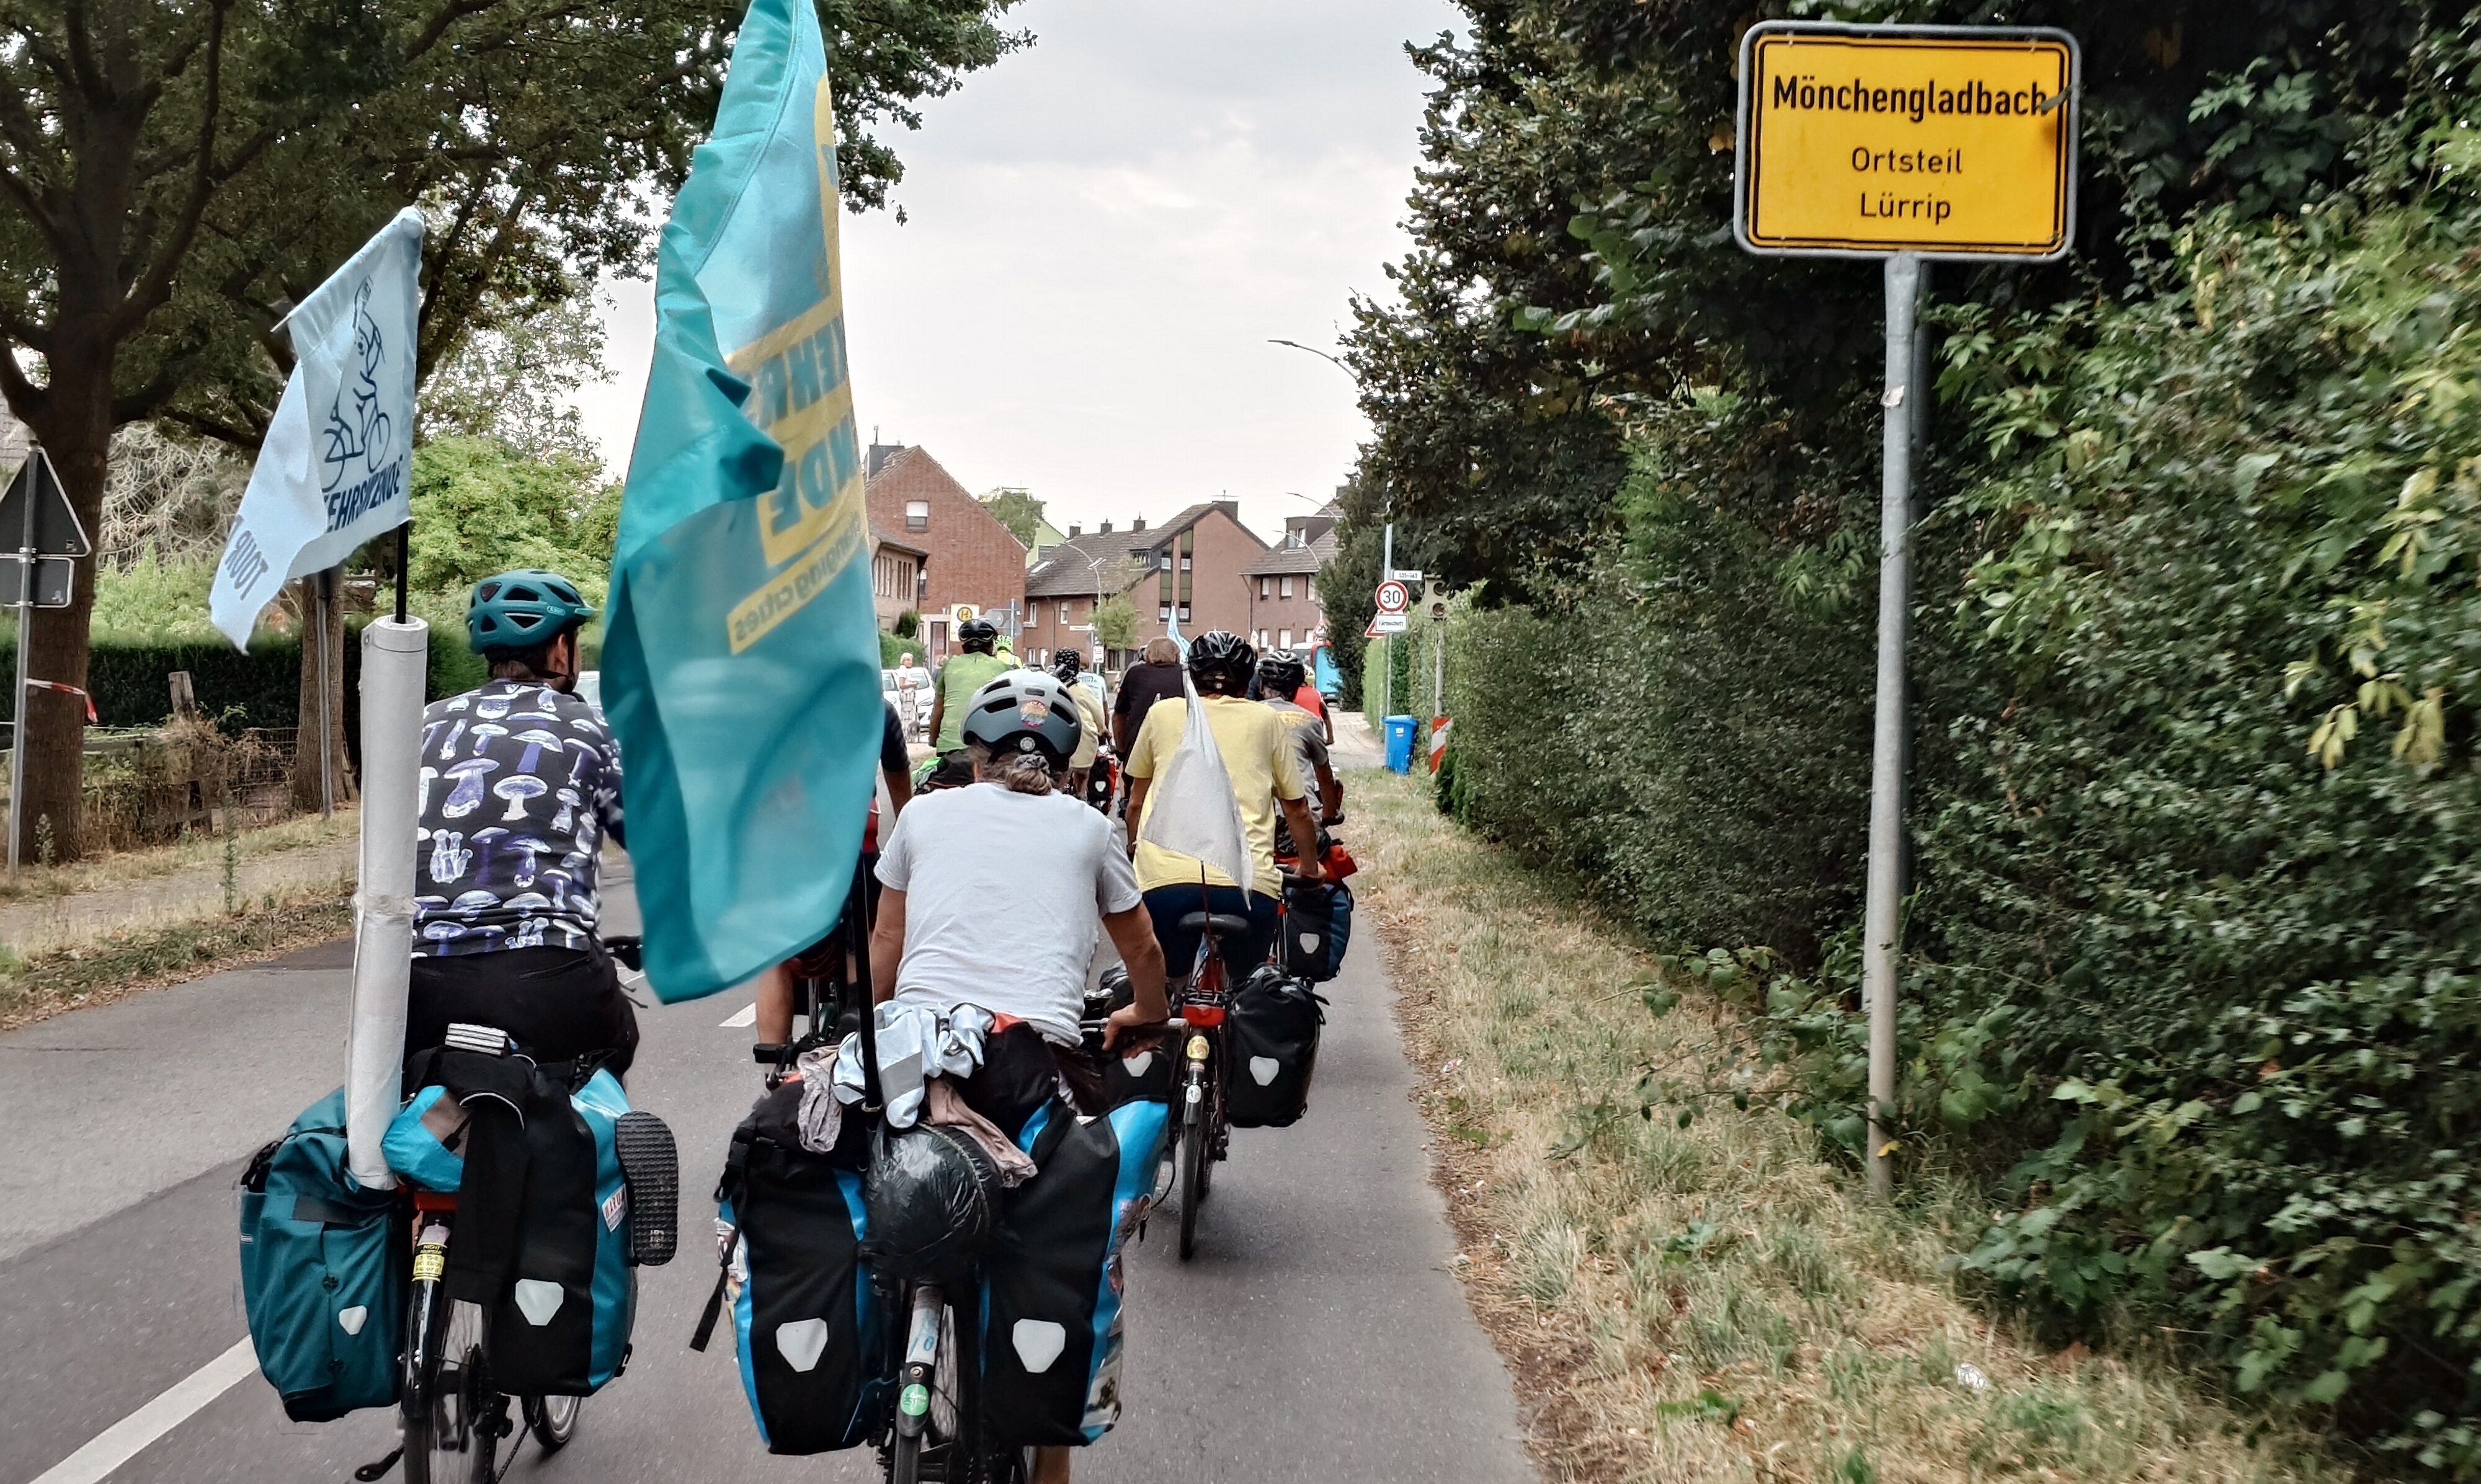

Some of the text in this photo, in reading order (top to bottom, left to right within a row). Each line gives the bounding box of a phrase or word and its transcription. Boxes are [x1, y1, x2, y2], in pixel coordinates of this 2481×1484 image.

[1773, 74, 2048, 123] Mönchengladbach
[1851, 147, 1963, 174] Ortsteil
[1860, 192, 1951, 225] Lürrip
[1383, 590, 1401, 604] 30
